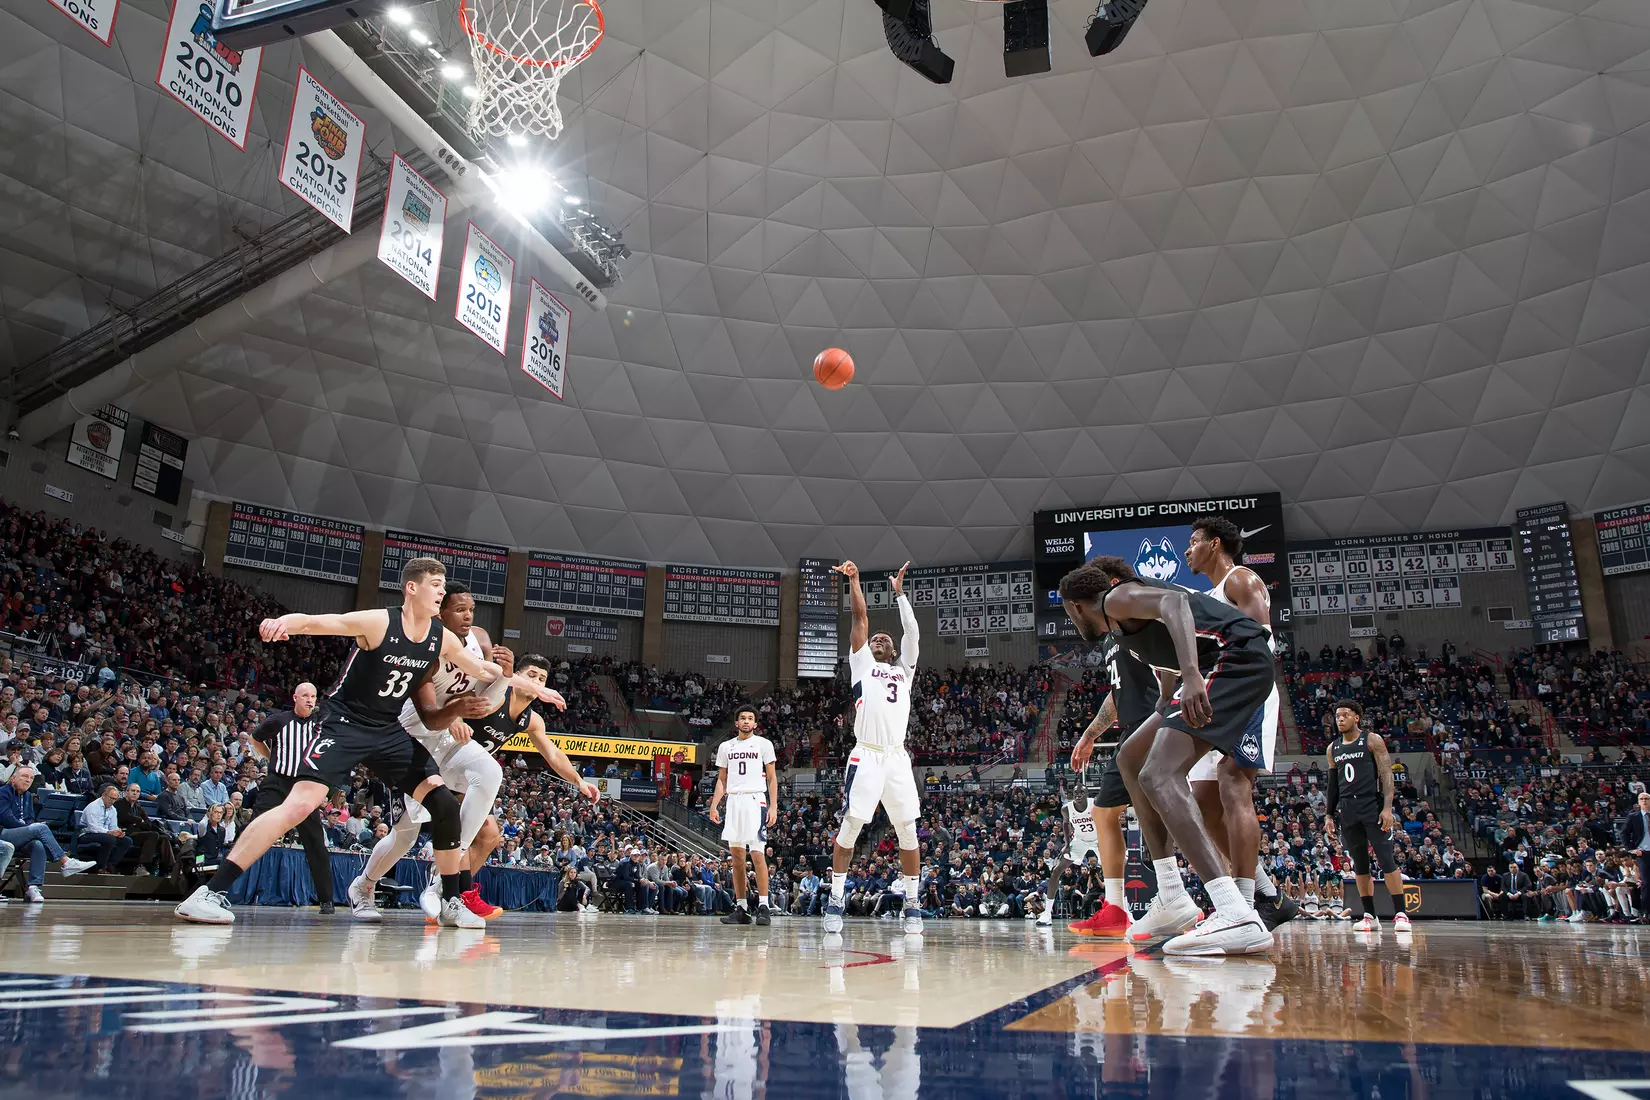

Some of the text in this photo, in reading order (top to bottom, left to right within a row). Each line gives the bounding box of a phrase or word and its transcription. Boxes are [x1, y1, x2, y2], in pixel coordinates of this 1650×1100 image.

[176, 41, 242, 107] 2010
[178, 70, 234, 121] NATIONAL
[306, 75, 329, 100] UConn
[170, 80, 236, 138] CHAMPIONS
[314, 94, 349, 128] Basketball
[295, 141, 348, 195] 2013
[296, 166, 341, 208] NATIONAL
[290, 176, 343, 222] CHAMPIONS
[391, 220, 432, 266] 2014
[392, 244, 428, 278] NATIONAL
[386, 253, 430, 291] CHAMPIONS
[466, 283, 501, 323] 2015
[467, 305, 498, 335] NATIONAL
[462, 314, 500, 347] CHAMPIONS
[531, 336, 560, 371] 2016
[531, 356, 557, 381] NATIONAL
[527, 365, 559, 393] CHAMPIONS
[235, 504, 362, 533] BIG EAST CONFERENCE
[1054, 498, 1258, 524] UNIVERSITY OF CONNECTICUT
[1530, 505, 1564, 515] HUSKIES
[1540, 516, 1560, 524] BOARD
[1603, 508, 1637, 520] NCAA
[234, 512, 361, 540] REGULAR SEASON CHAMPIONS
[173, 533, 184, 542] 212
[1044, 537, 1075, 546] WELLS
[1369, 535, 1409, 544] HUSKIES
[397, 541, 497, 560] TOURNAMENT CHAMPIONS
[473, 545, 506, 554] CONFERENCE
[1046, 545, 1074, 554] FARGO
[228, 557, 281, 570] CONNECTICUT
[309, 571, 354, 582] BASKETBALL
[566, 557, 598, 565] INVITATION
[601, 560, 641, 569] TOURNAMENT
[913, 566, 947, 575] HUSKIES
[1293, 565, 1311, 577] 52
[1348, 562, 1367, 573] 00
[1377, 560, 1394, 571] 13
[1405, 558, 1424, 570] 42
[1437, 556, 1449, 568] 34
[1466, 554, 1477, 566] 32
[1494, 552, 1508, 564] 50
[703, 569, 774, 579] CHAMPIONSHIP
[874, 594, 880, 604] 9
[916, 590, 932, 601] 25
[941, 589, 957, 599] 42
[964, 587, 981, 598] 44
[1014, 584, 1030, 595] 42
[1301, 589, 1449, 609] 15 22 42 13 3
[528, 601, 573, 610] CONNECTICUT
[1280, 608, 1290, 622] 12
[941, 616, 1006, 630] 24 13 22
[1045, 622, 1055, 635] 10
[1548, 626, 1577, 640] 12:19
[383, 654, 429, 669] CINCINNATI
[42, 664, 85, 682] SEC 109
[446, 672, 470, 694] 25
[378, 670, 413, 698] 33
[887, 683, 897, 703] 3
[508, 736, 530, 748] SOME
[565, 741, 587, 752] SOME
[589, 743, 612, 753] LEAD.
[614, 744, 636, 754] SOME
[637, 745, 649, 755] DO
[651, 746, 674, 757] BOTH.
[728, 752, 758, 761] UCONN
[739, 761, 746, 775] 0
[1344, 763, 1355, 782] 0
[1080, 824, 1094, 832] 23
[1405, 893, 1419, 908] ps
